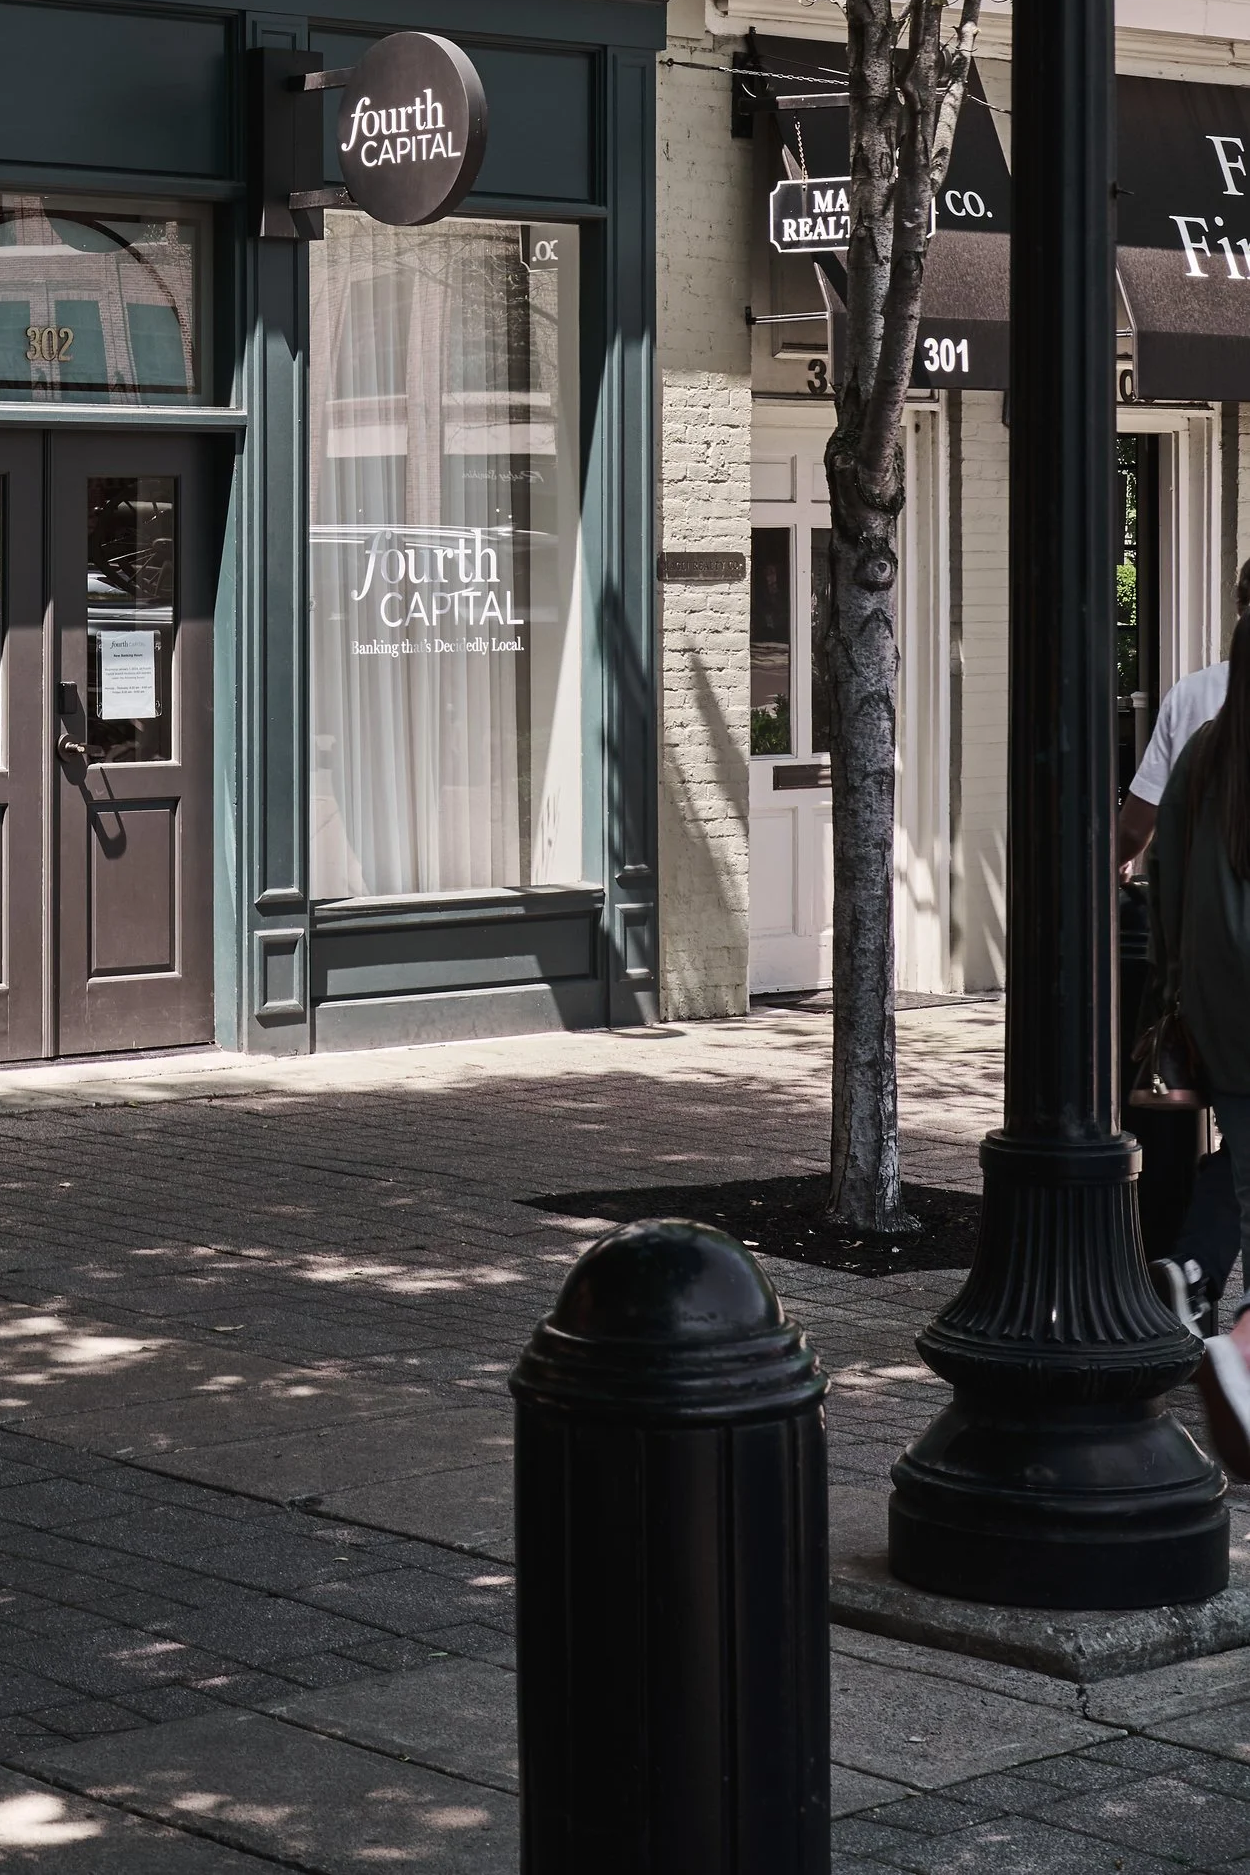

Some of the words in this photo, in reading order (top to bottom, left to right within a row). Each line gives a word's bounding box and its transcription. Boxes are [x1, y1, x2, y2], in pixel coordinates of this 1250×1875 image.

[341, 88, 445, 151] fourth
[360, 131, 461, 167] CAPITAL
[945, 190, 993, 218] CO.
[25, 326, 74, 362] 302
[923, 337, 969, 373] 301
[351, 529, 500, 601] fourth
[380, 590, 525, 628] CAPITAL
[110, 640, 128, 649] fourth
[351, 639, 399, 657] Banking
[434, 637, 490, 656] Decidedly
[491, 636, 525, 652] Local.
